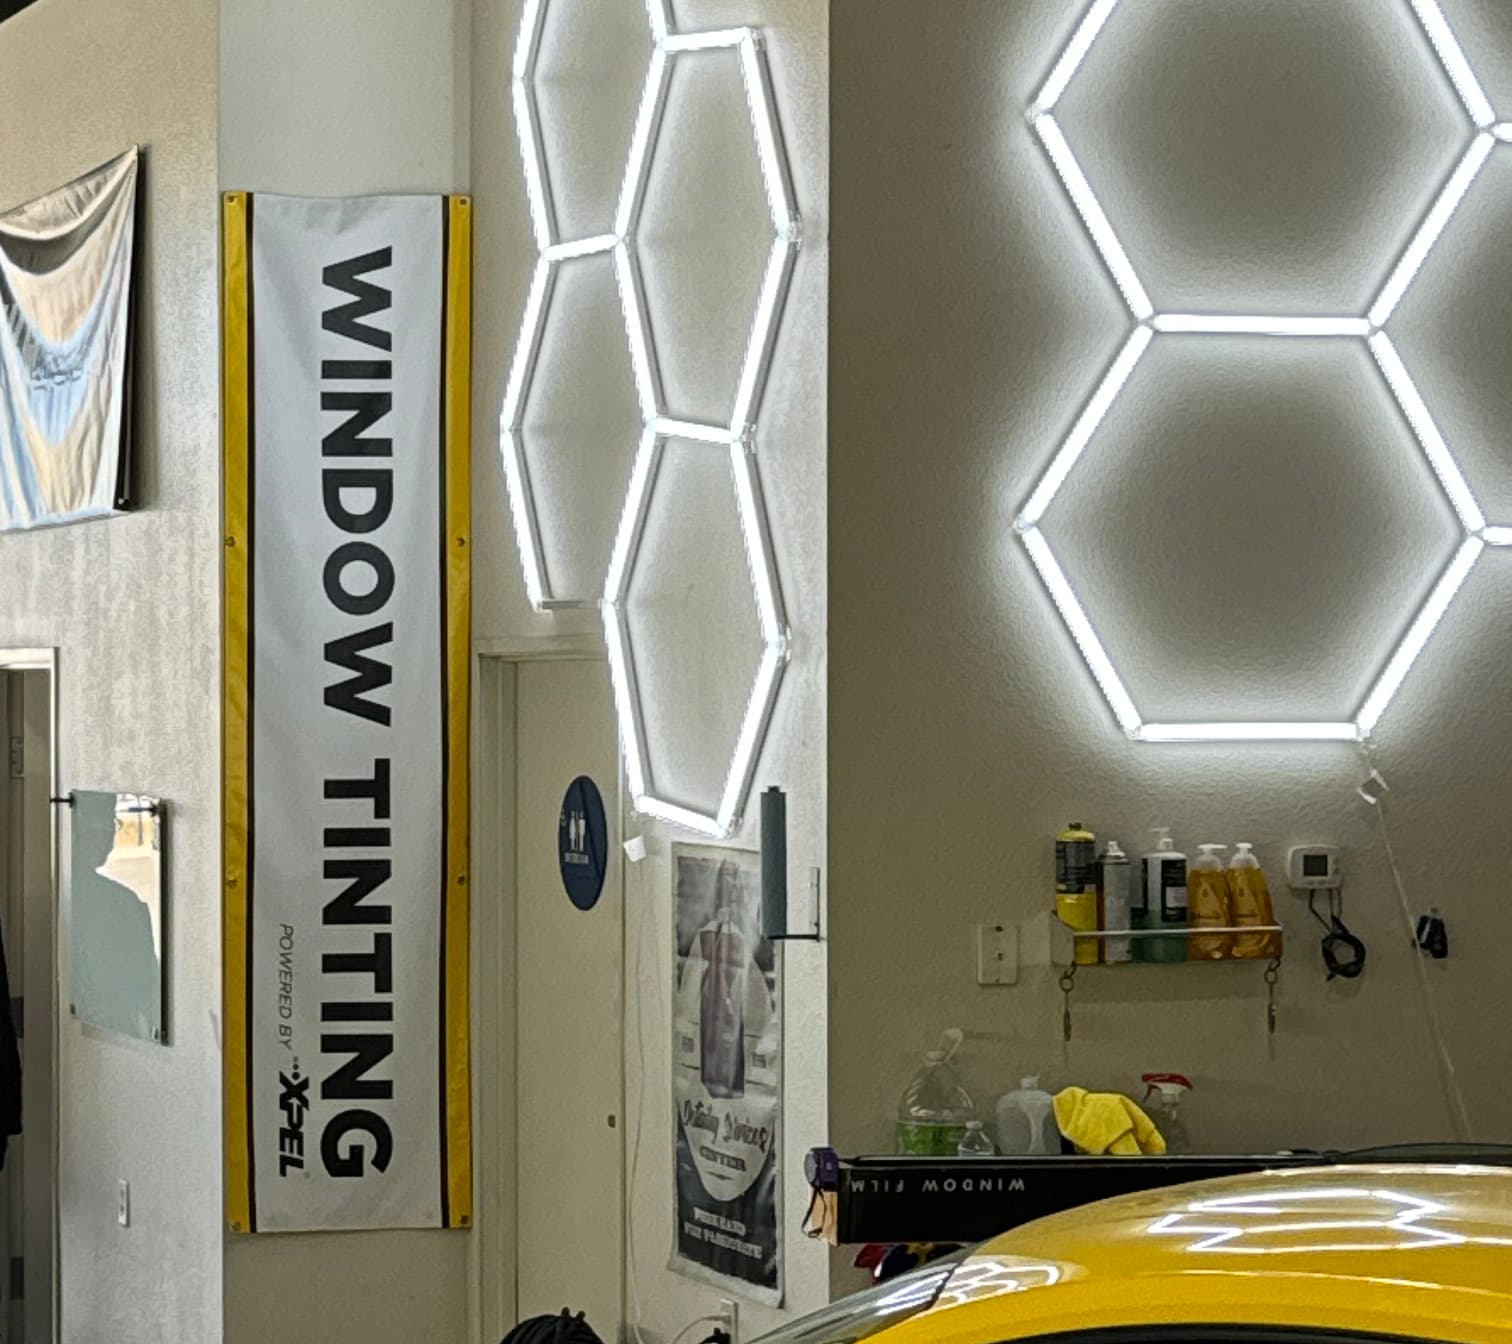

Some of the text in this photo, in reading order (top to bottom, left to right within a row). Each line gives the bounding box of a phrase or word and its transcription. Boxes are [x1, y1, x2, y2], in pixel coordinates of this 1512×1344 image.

[319, 246, 395, 1178] WINDOW TINTING
[278, 923, 310, 1178] POWERED BY XPEL
[850, 1178, 1025, 1193] WINDOW FILM
